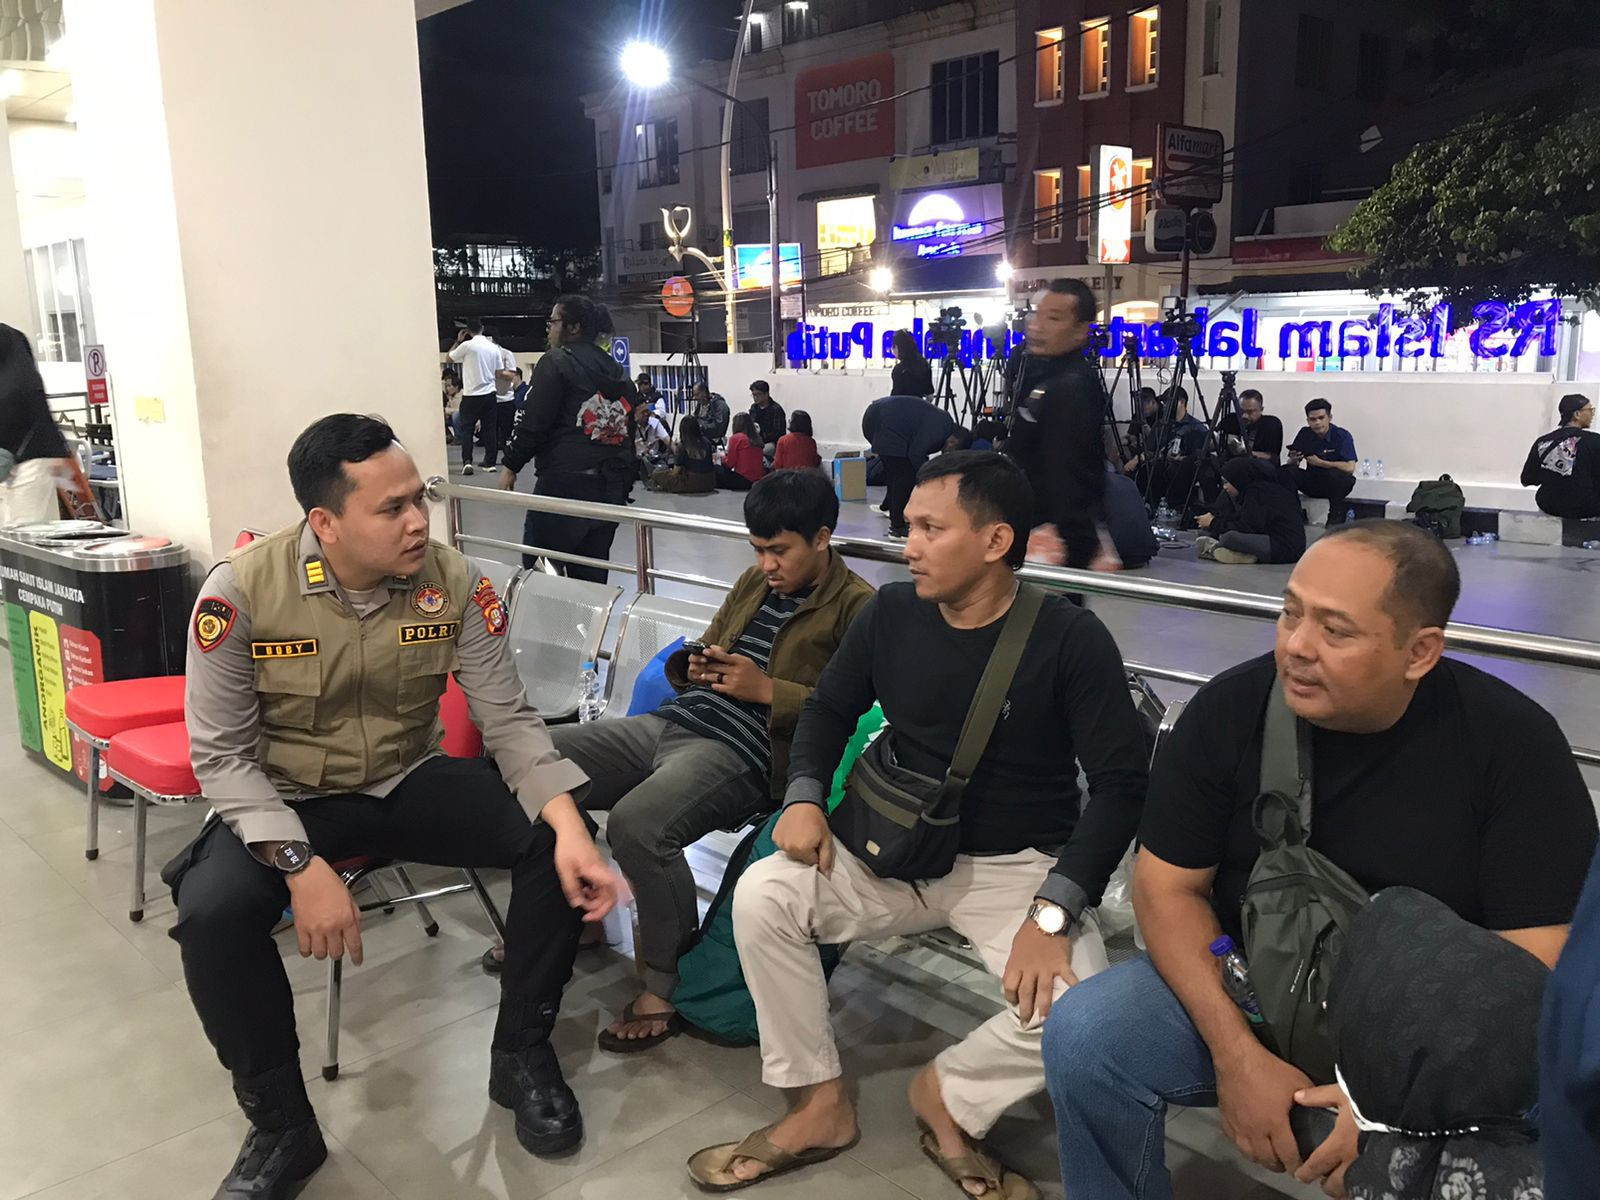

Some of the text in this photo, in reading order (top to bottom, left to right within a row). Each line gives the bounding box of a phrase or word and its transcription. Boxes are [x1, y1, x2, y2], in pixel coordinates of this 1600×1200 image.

[807, 79, 881, 113] TOMORO
[810, 108, 878, 140] COFFEE
[1167, 132, 1218, 156] Alfamart
[54, 582, 85, 604] JAKARTA
[33, 626, 48, 731] ANORGANIK
